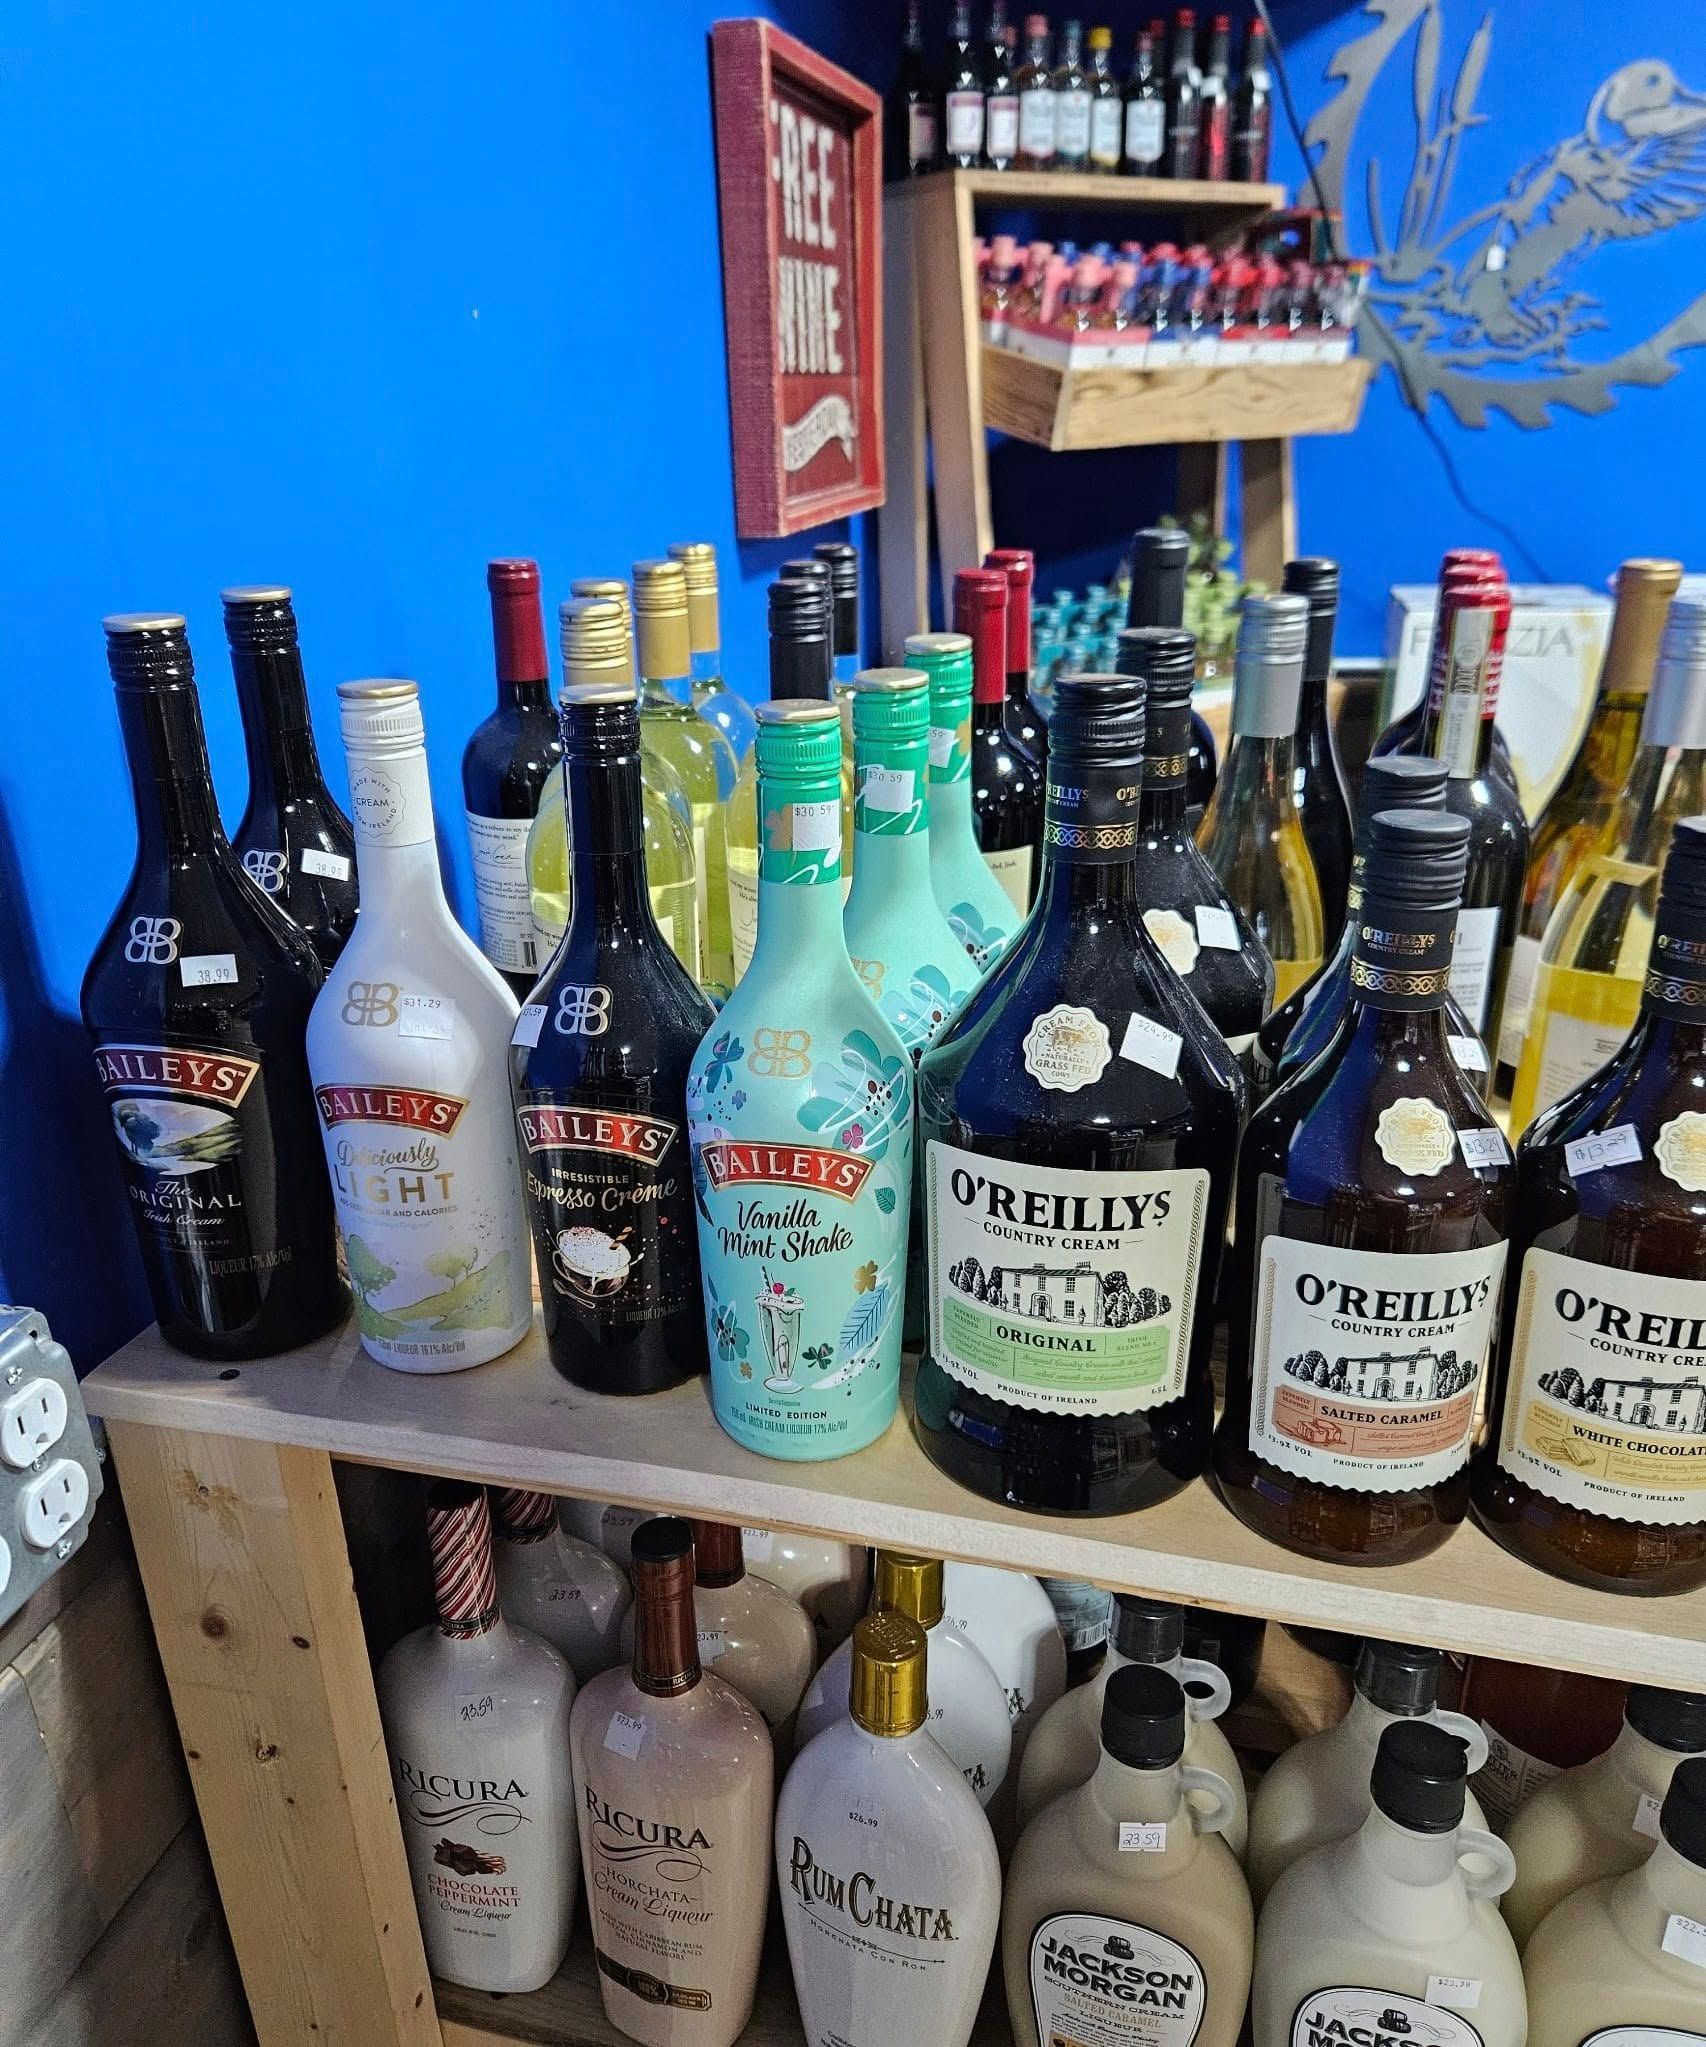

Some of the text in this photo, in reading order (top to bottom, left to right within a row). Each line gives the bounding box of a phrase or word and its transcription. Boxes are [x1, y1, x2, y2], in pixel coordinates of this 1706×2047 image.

[371, 778, 390, 793] WITH
[356, 797, 389, 807] CREAM
[794, 805, 814, 818] $30
[369, 808, 397, 829] IRELAND
[314, 862, 343, 877] 38.99
[197, 968, 230, 984] 38.99
[402, 997, 442, 1009] $31.29
[1038, 1016, 1074, 1039] CREAM
[1137, 1018, 1175, 1043] $24.99
[95, 1053, 241, 1092] BAILEYS
[1035, 1059, 1092, 1075] GRASS FED
[321, 1090, 453, 1126] BAILEYS
[522, 1111, 662, 1153] BAILEYS
[337, 1137, 440, 1174] Deliciously
[551, 1168, 629, 1184] IRRESISTIBLE
[708, 1149, 859, 1188] BAILEYS
[155, 1180, 194, 1196] The
[334, 1162, 456, 1204] LIGHT
[527, 1169, 679, 1212] Espresso Crème
[130, 1185, 242, 1210] ORIGINAL
[950, 1167, 1172, 1233] O'REILLYS
[143, 1208, 225, 1226] Irish Cream
[414, 1204, 459, 1217] CALORIES
[738, 1198, 821, 1231] Vanilla
[718, 1221, 854, 1263] Mint Shake
[983, 1220, 1121, 1251] COUNTRY CREAM
[1295, 1272, 1492, 1323] O'REILLYS
[995, 1324, 1097, 1353] ORIGINAL
[1330, 1318, 1456, 1338] COUNTRY CREAM
[1589, 1336, 1669, 1365] COUNTRY
[962, 1365, 979, 1380] VOL
[997, 1382, 1098, 1405] PRODUCT OF IRELAND
[745, 1401, 828, 1420] LIMITED EDITION
[1320, 1405, 1444, 1426] SALTED CARAMEL
[764, 1419, 786, 1434] CREAM
[786, 1422, 813, 1436] LIQUEUR
[814, 1423, 828, 1435] 17%
[1572, 1425, 1625, 1449] WHITE
[1294, 1444, 1313, 1459] VOL
[1332, 1458, 1424, 1471] PRODUCT OF IRELAND
[1543, 1462, 1563, 1478] VOL
[1583, 1481, 1685, 1502] PRODUCT OF IRELAND
[459, 1694, 494, 1722] 23.59
[616, 1713, 642, 1732] $23.99
[399, 1757, 528, 1801] RICURA
[585, 1783, 713, 1850] RICURA
[849, 1811, 879, 1829] $26.99
[427, 1872, 519, 1897] CHOCOLATE
[428, 1884, 522, 1908] PEPPERMINT
[606, 1865, 690, 1904] HORCHATA
[594, 1870, 714, 1926] Cream Liqueur
[440, 1900, 513, 1922] Cream Liqueur
[809, 1917, 866, 1953] HORCHATA
[1040, 1935, 1195, 1992] JACKSON
[1043, 1952, 1187, 2010] MORGAN
[1044, 1975, 1185, 2020] SOUTHERN CREAM
[1063, 1992, 1162, 2029] SALTED CARAMEL
[1079, 2010, 1144, 2034] LIQUEUR
